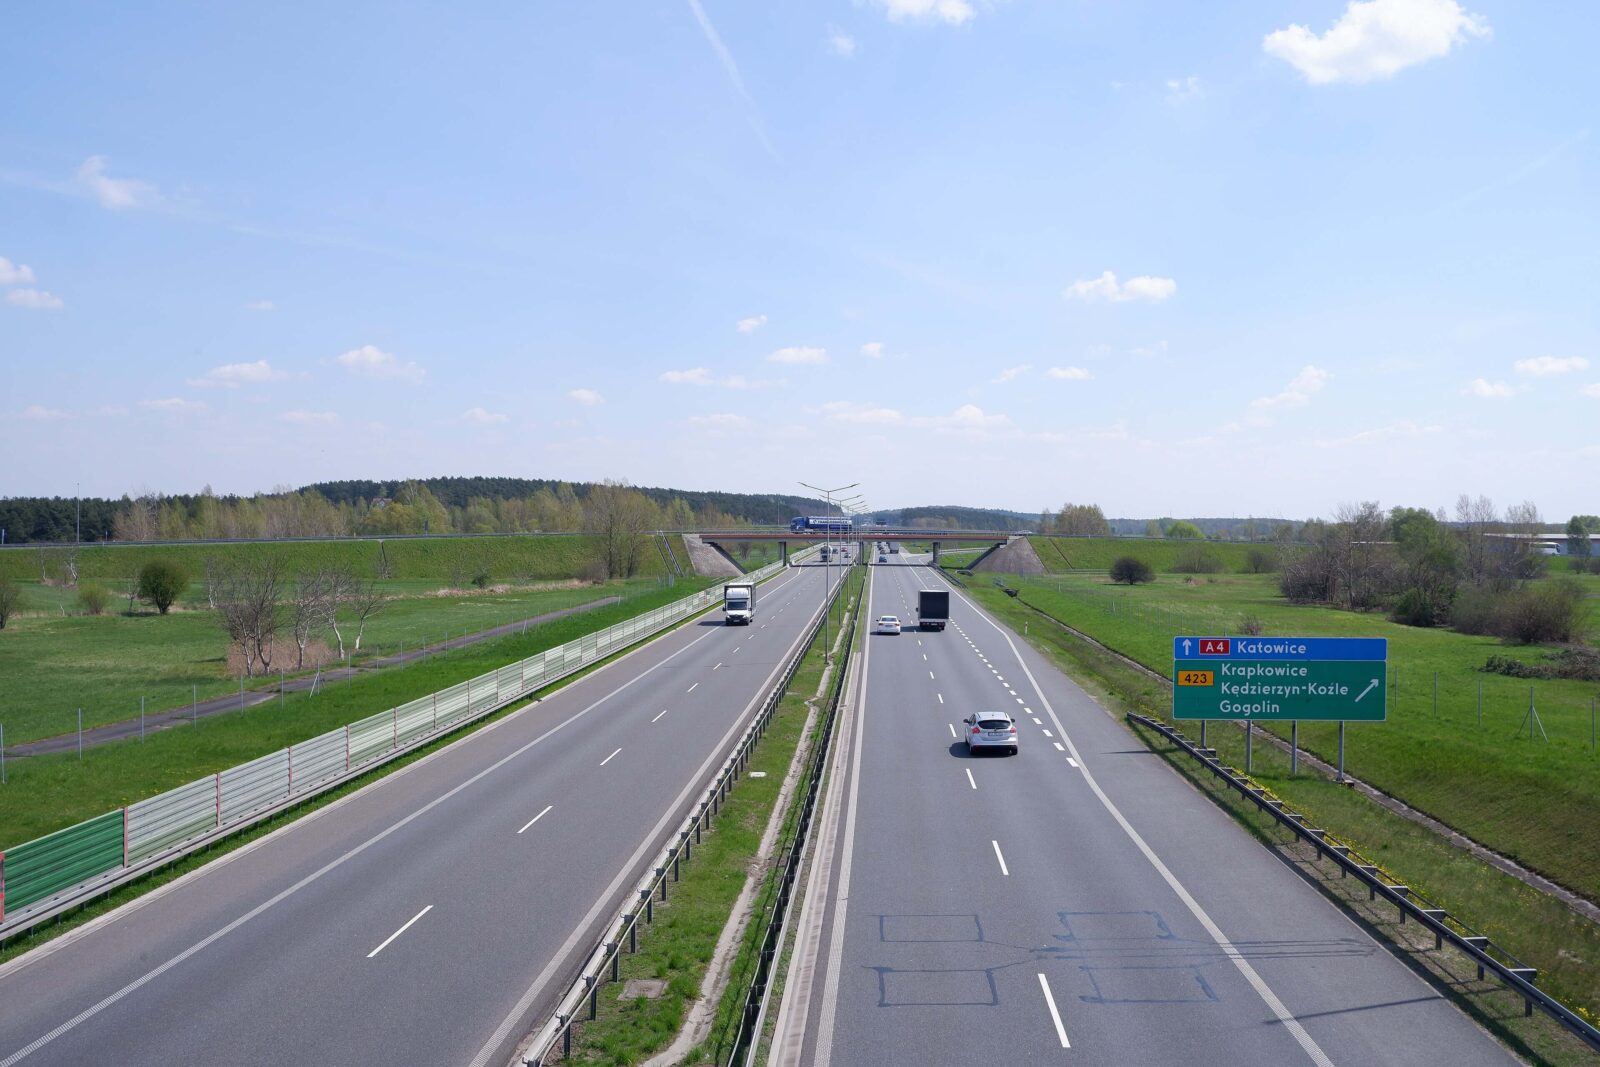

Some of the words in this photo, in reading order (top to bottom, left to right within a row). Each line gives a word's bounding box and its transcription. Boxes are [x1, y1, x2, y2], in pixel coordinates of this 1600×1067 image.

[1205, 641, 1225, 653] A4
[1237, 641, 1307, 654] Katowice
[1184, 673, 1208, 684] 423
[1221, 663, 1308, 679] Krapkowice
[1221, 682, 1349, 698] Kędzierzyn-Koźle
[1219, 700, 1280, 716] Gogolin
